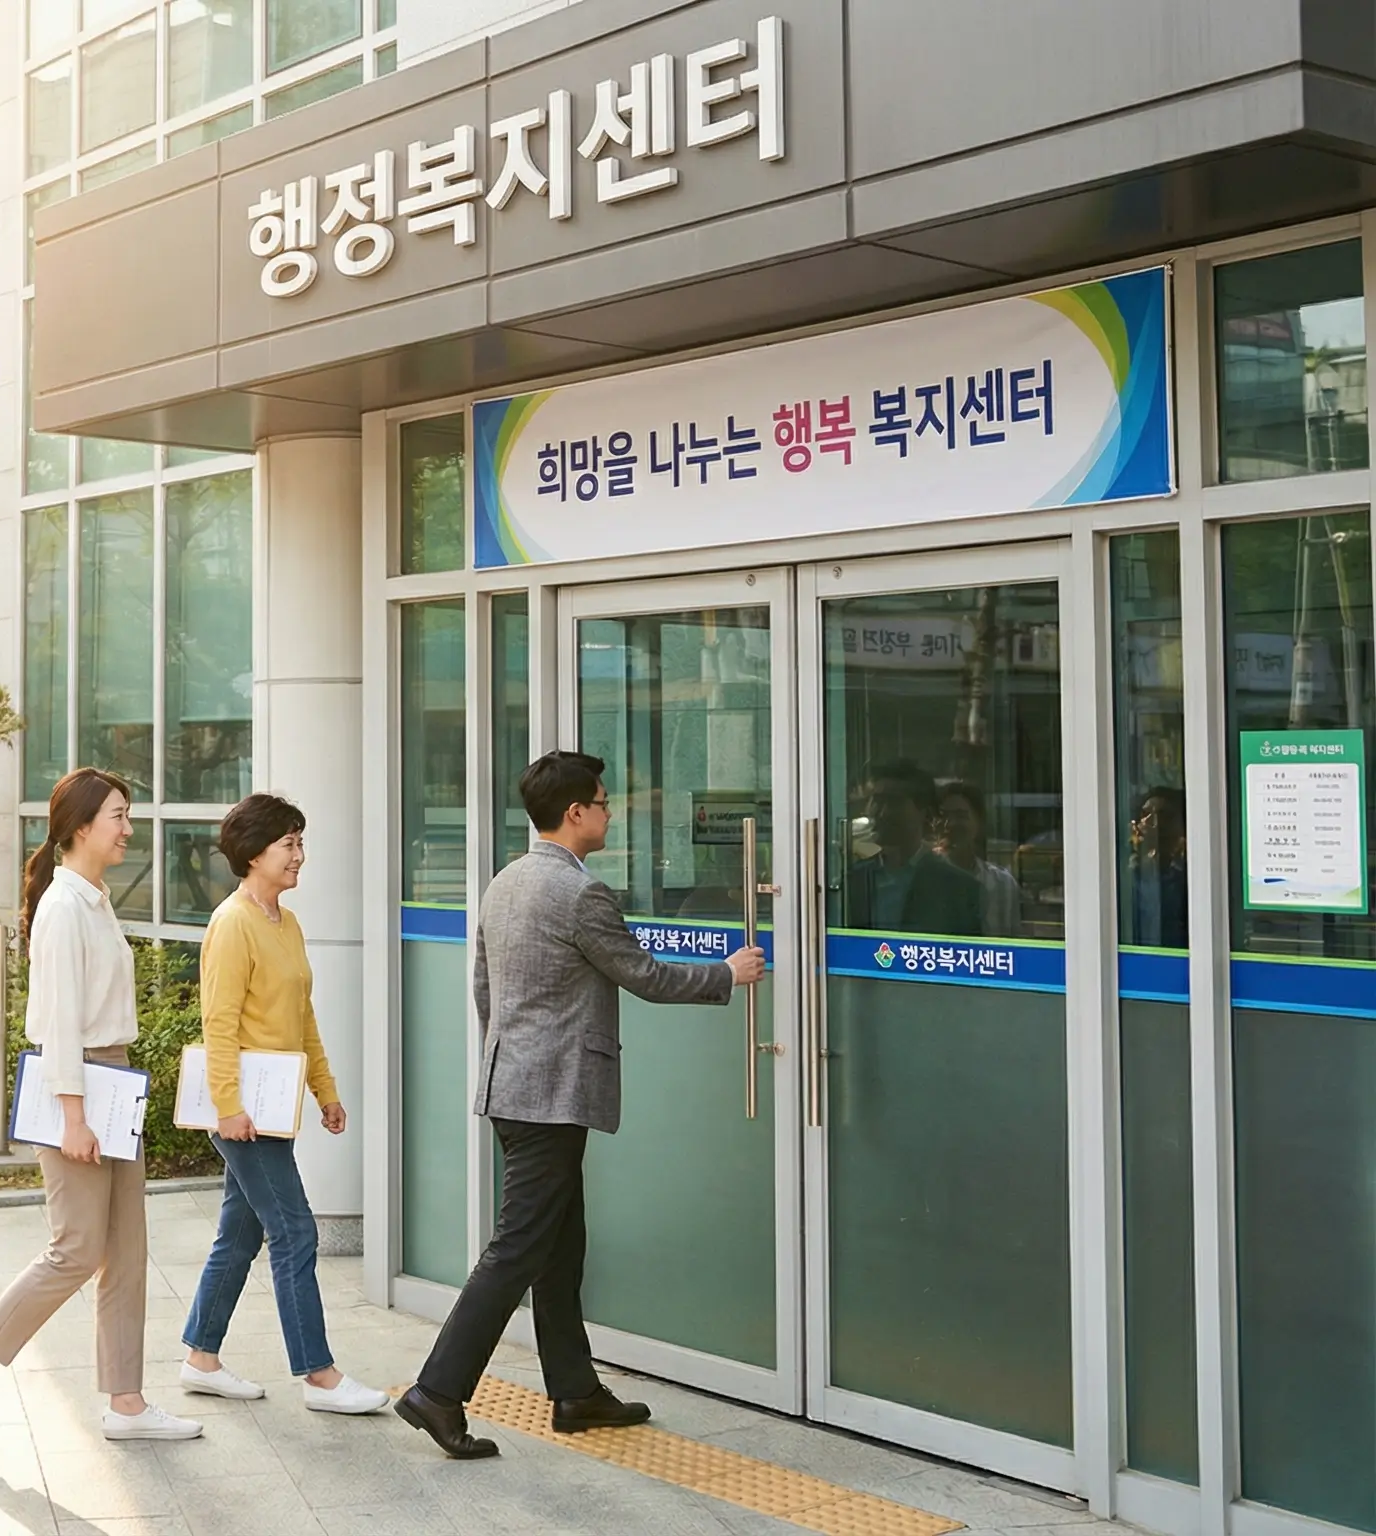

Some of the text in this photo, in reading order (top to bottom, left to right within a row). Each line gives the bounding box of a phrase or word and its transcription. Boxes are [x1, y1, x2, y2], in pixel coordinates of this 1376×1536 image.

[247, 15, 786, 299] 행정복지센터
[536, 358, 1055, 502] 희망을 나누는 행복 복지센터
[899, 944, 1014, 976] 행정복지센터
